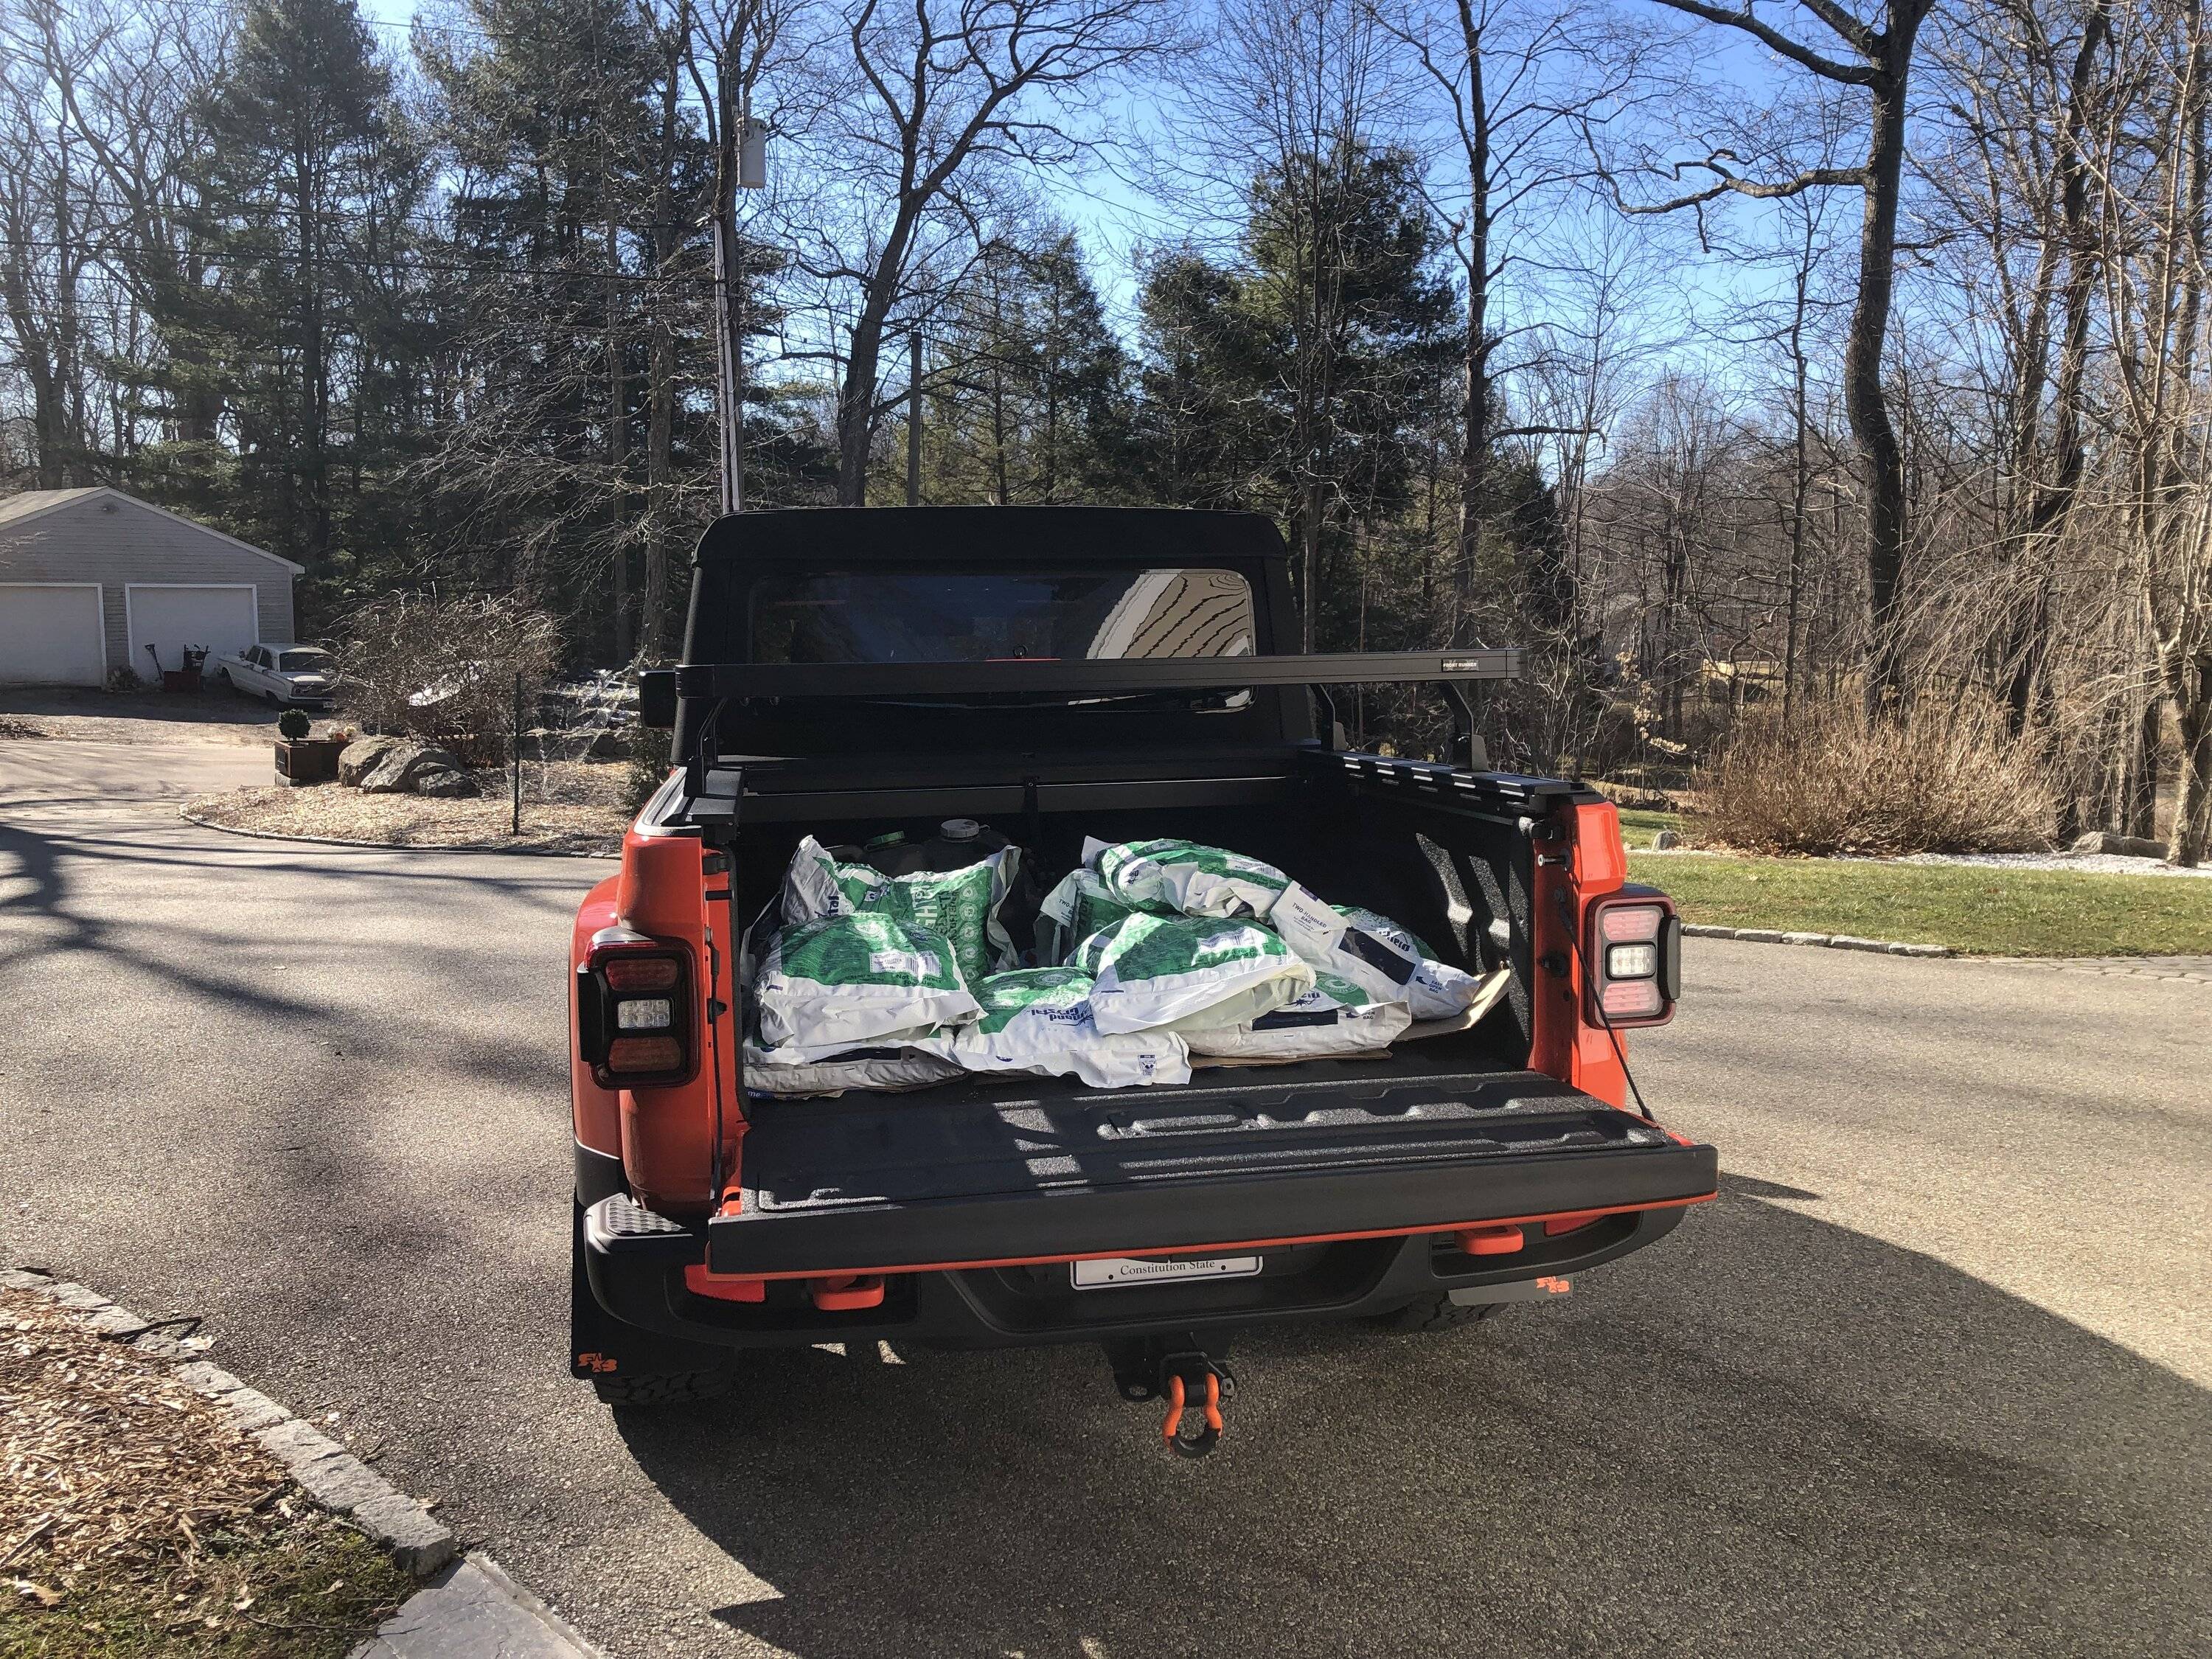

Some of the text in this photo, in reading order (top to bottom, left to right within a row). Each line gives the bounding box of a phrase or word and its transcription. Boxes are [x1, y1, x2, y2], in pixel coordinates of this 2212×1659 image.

[1293, 902, 1327, 928] TWO-HANDLED
[1301, 916, 1312, 925] BAG
[1120, 1260, 1215, 1276] Constitution State
